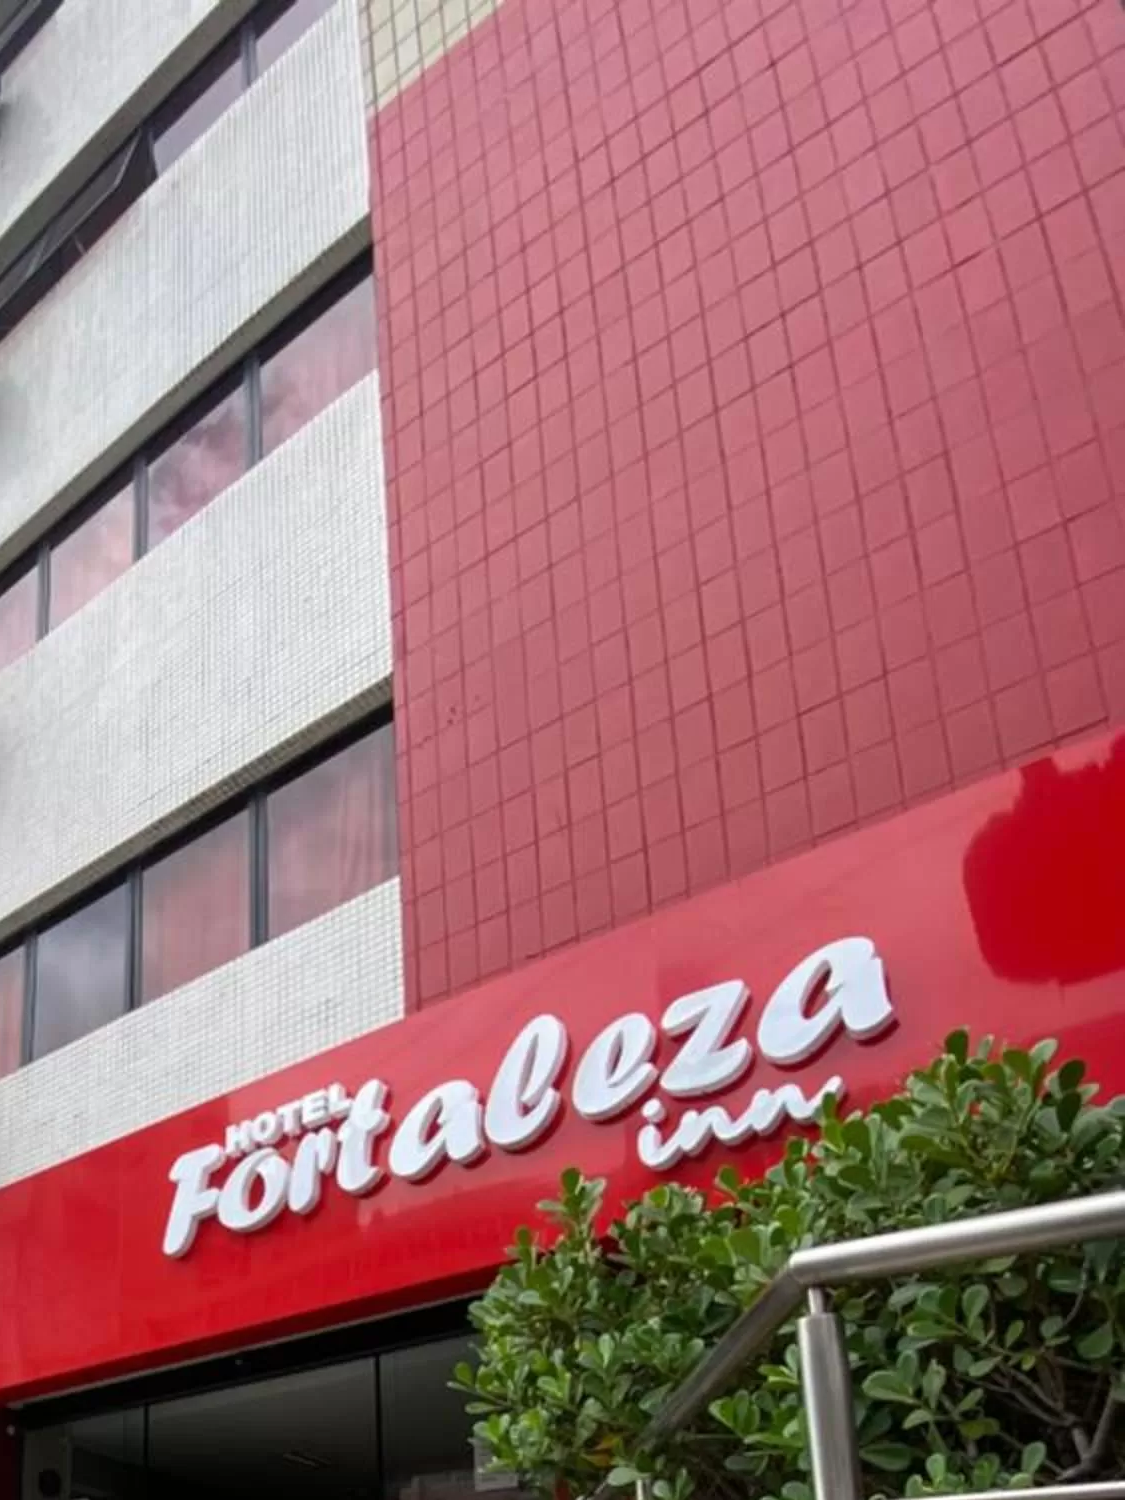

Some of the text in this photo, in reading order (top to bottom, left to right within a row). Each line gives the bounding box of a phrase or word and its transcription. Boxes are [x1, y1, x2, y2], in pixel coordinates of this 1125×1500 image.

[161, 936, 895, 1257] Fortaleza
[225, 1082, 353, 1157] HOTEL
[637, 1074, 845, 1171] inn
